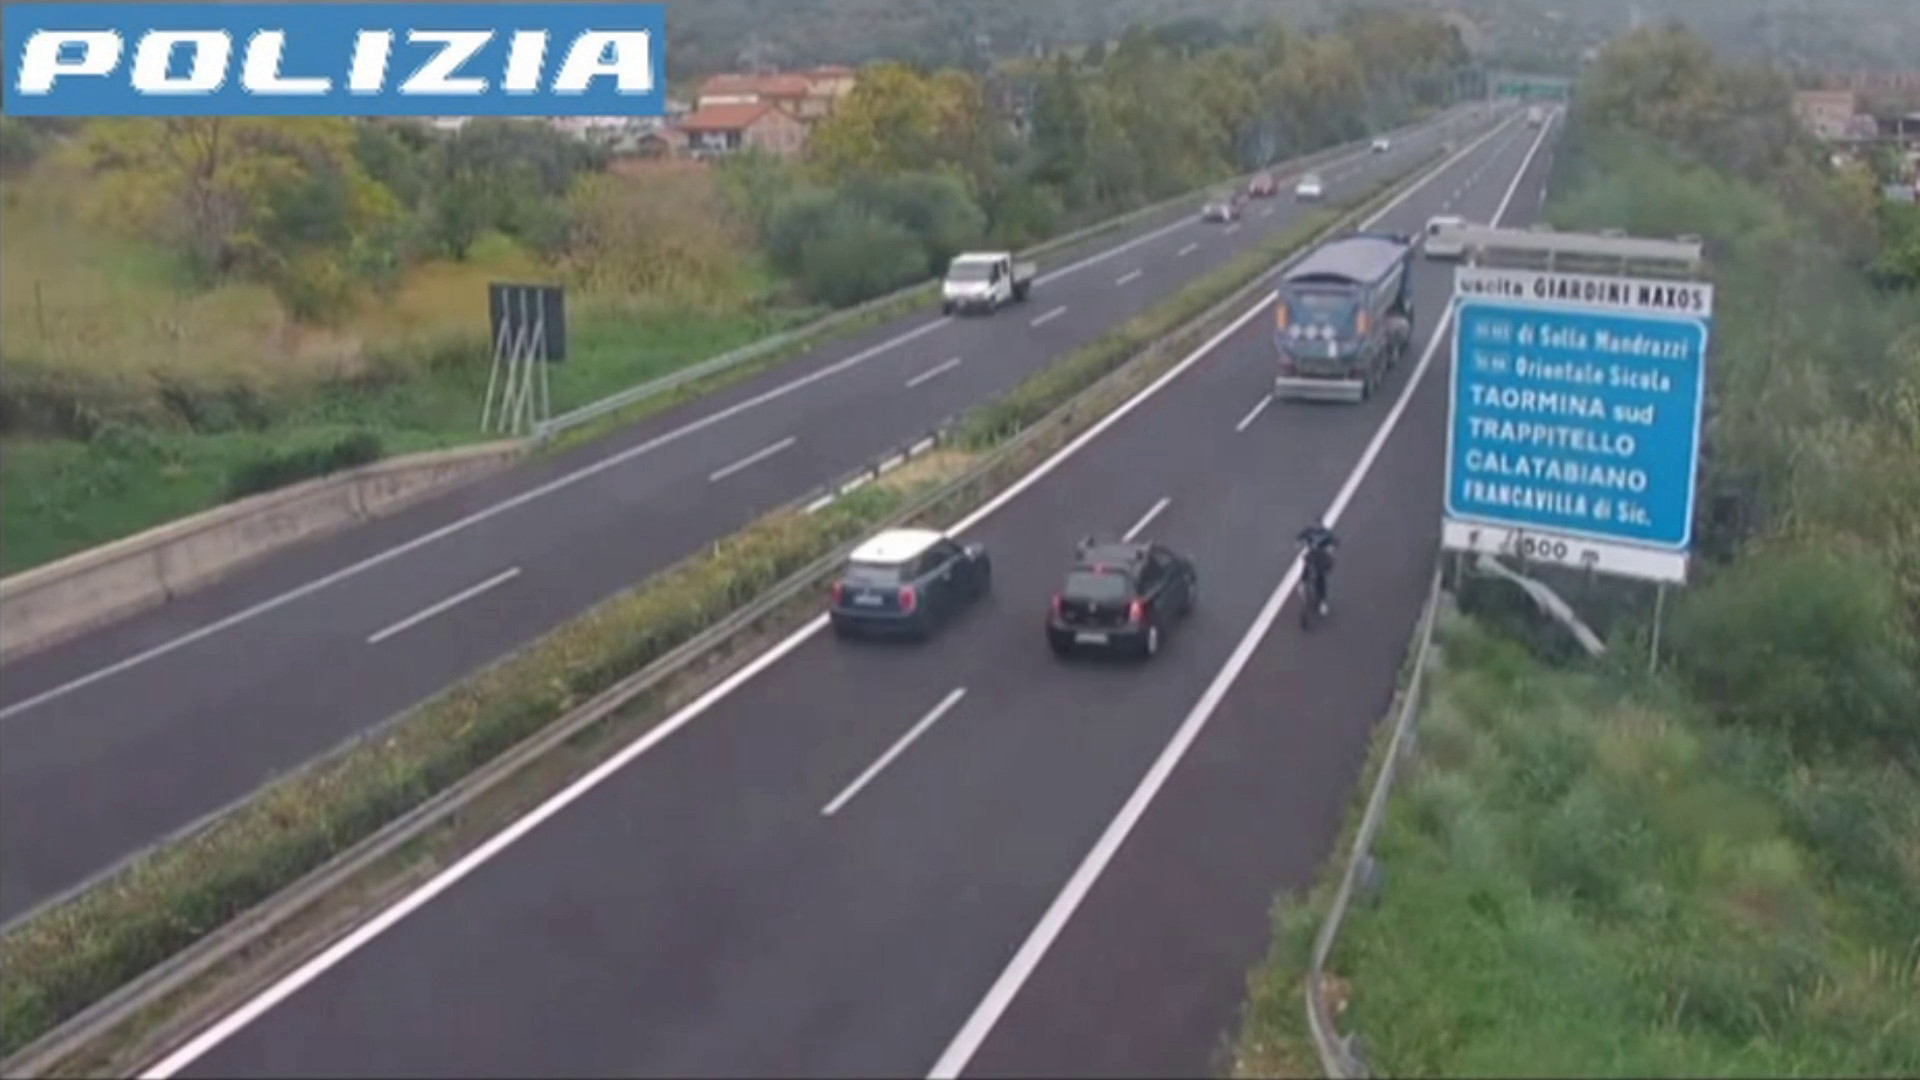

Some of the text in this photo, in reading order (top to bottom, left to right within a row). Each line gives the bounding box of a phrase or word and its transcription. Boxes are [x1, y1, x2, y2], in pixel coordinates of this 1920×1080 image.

[1533, 277, 1630, 301] GIARDINI
[1639, 285, 1703, 310] NAXOS
[1516, 355, 1604, 384] Orientale
[1469, 384, 1655, 426] TAORMINA sud
[1468, 416, 1636, 457] TRAPPITELLO
[1465, 448, 1647, 492] CALATABIANO
[1463, 478, 1652, 527] FRANCAVILLA di Sic.
